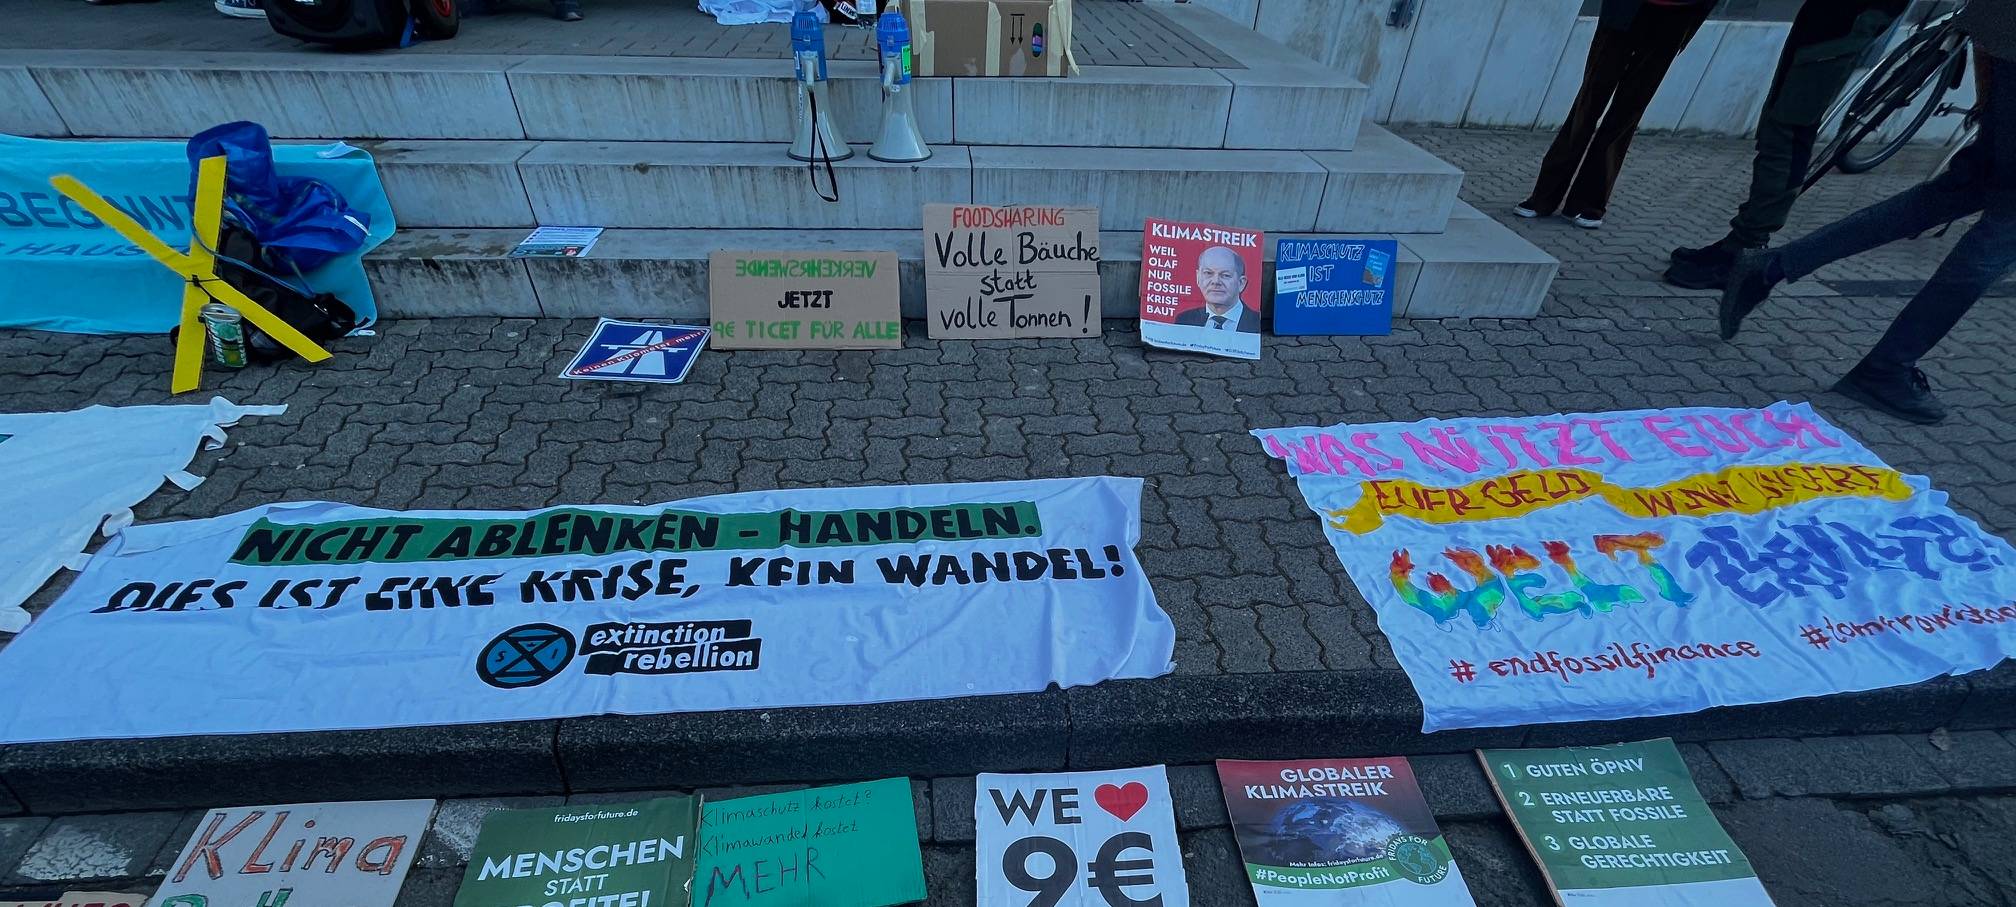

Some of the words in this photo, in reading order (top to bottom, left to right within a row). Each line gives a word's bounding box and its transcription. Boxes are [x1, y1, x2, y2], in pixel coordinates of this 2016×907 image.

[953, 207, 1065, 228] FOODSHARING
[1151, 222, 1257, 248] KLIMASTREIK
[934, 231, 1007, 268] Volle
[1149, 244, 1177, 257] WEIL
[1280, 242, 1365, 262] KLIMASCHUTZ
[1148, 257, 1178, 269] OLAF
[1309, 264, 1335, 283] IST
[980, 268, 1037, 295] statt
[1148, 269, 1172, 281] NUR
[1147, 282, 1192, 295] FOSSILE
[1296, 289, 1385, 308] MENSCHENSCHUTZ
[777, 290, 834, 309] JETZT
[1146, 294, 1179, 306] KRISE
[940, 296, 998, 330] volle
[992, 294, 1072, 328] Tonnen
[1146, 305, 1176, 317] BAUT
[745, 320, 802, 340] TICET
[810, 319, 845, 339] FÜR
[852, 320, 900, 340] ALLE
[618, 342, 671, 362] Kilometer
[1263, 432, 1404, 477] WAS
[1643, 409, 1842, 458] EUCH
[1480, 472, 1593, 508] GELD
[235, 523, 423, 563] NICHT
[426, 512, 720, 560] ABLENKEN
[780, 505, 1038, 546] HANDELN.
[257, 576, 362, 610] IST
[519, 557, 702, 604] KRISE,
[876, 545, 1127, 588] WANDEL!
[1389, 532, 1697, 630] WELT
[590, 624, 725, 646] extinction
[623, 642, 753, 670] rebellion
[1280, 765, 1394, 783] GLOBALER
[1503, 764, 1517, 778] 1
[1525, 763, 1588, 779] GUTEN
[1590, 757, 1645, 776] ÖPNV
[1244, 781, 1389, 800] KLIMASTREIK
[1518, 791, 1535, 806] 2
[1540, 786, 1674, 806] ERNEUERBARE
[553, 808, 640, 824] fridaysforfuture.de
[701, 800, 800, 827] Klimaschutz
[988, 788, 1082, 826] WE
[1552, 809, 1606, 824] STATT
[1611, 804, 1688, 822] FOSSILE
[702, 824, 808, 857] Klimawandel
[813, 820, 858, 840] kostet
[1387, 835, 1408, 862] FRIDAYS
[1408, 835, 1429, 847] FOR
[1544, 835, 1561, 851] 3
[1568, 834, 1656, 850] GLOBALE
[477, 835, 685, 882] MENSCHEN
[1580, 849, 1733, 869] GERECHTIGKEIT
[543, 873, 609, 896] STATT
[704, 846, 826, 907] MEHR
[1256, 866, 1390, 887] #PeopleNotProfit
[1417, 864, 1448, 884] FUTURE
